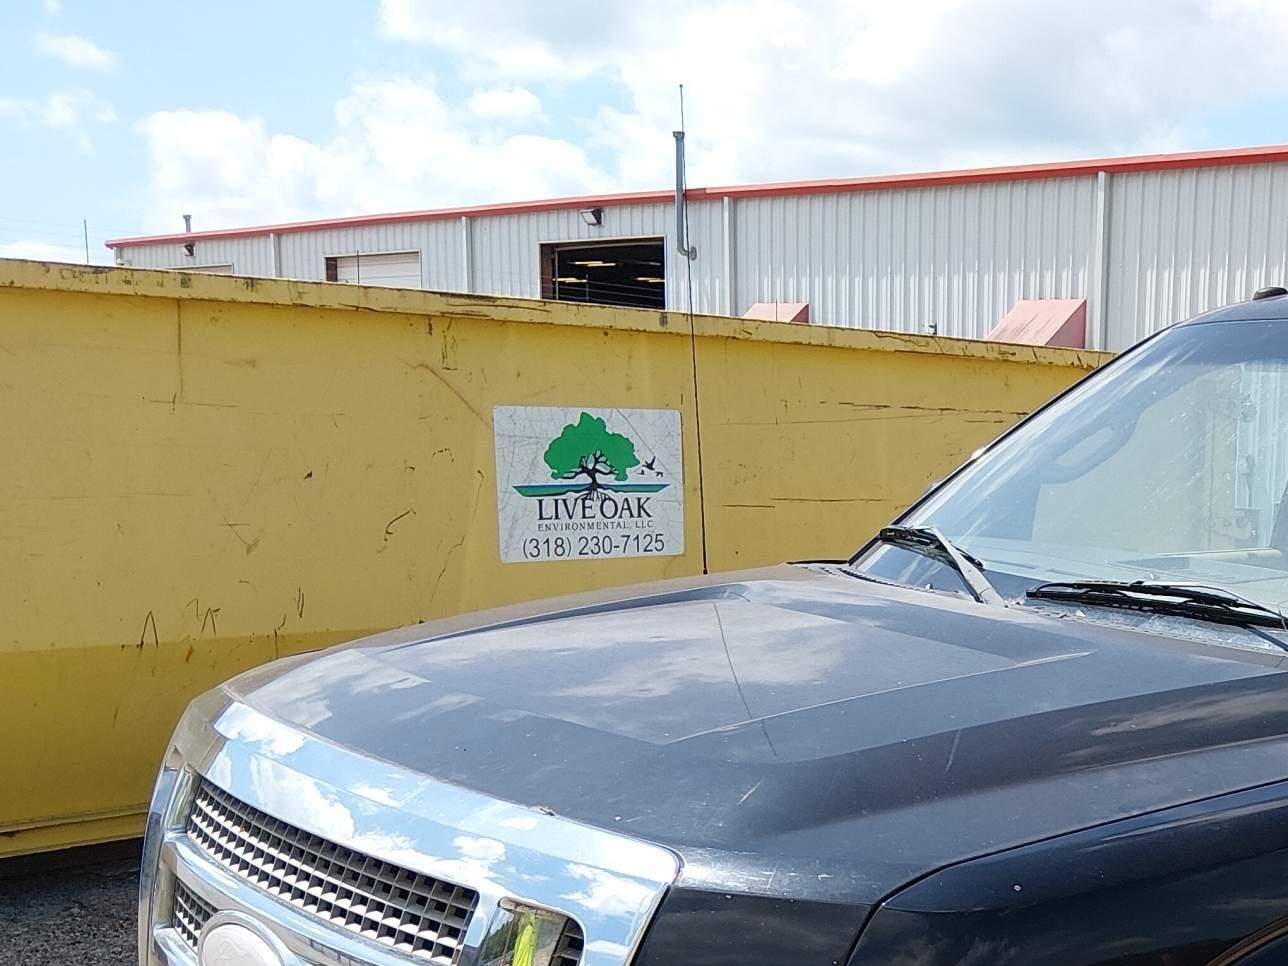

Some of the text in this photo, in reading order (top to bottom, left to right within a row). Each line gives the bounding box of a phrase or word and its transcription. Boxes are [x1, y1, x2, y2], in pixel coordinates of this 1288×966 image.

[536, 497, 653, 521] LIVE OAK
[537, 520, 653, 532] ENVIRONMENTAL, LLC
[522, 533, 665, 559] (318) 230-7125
